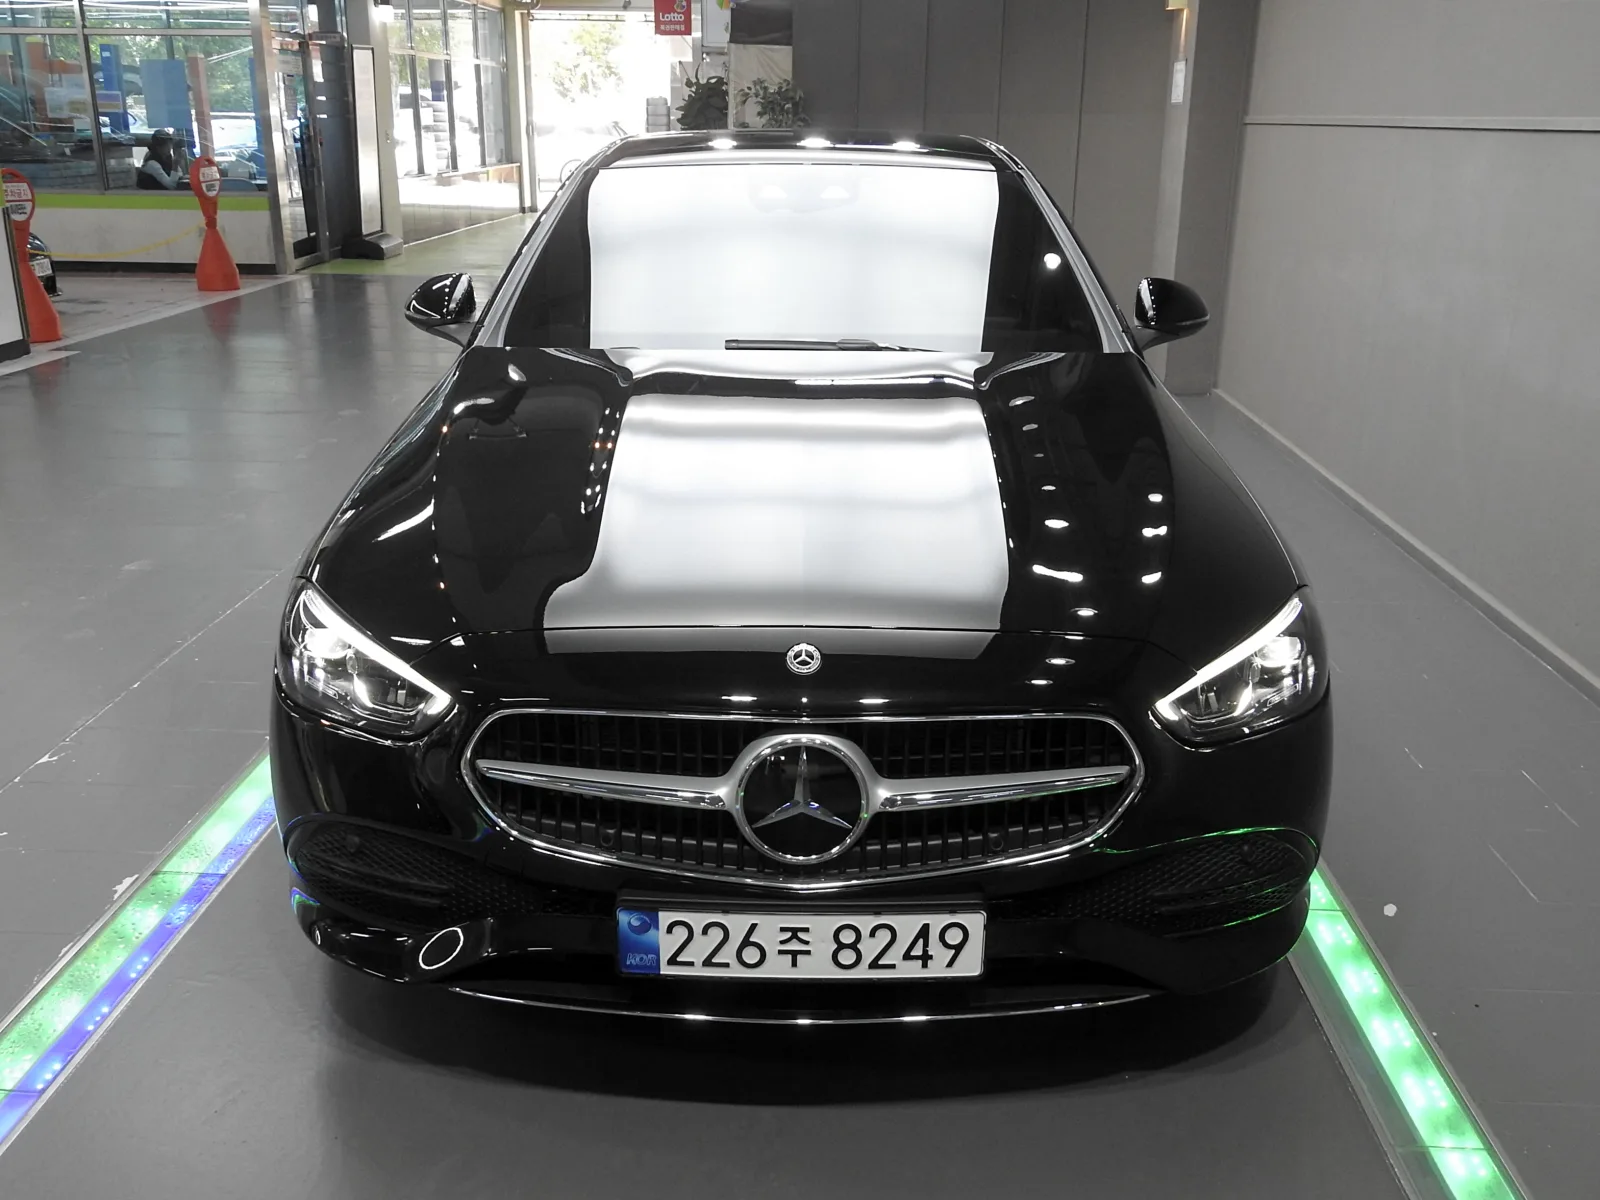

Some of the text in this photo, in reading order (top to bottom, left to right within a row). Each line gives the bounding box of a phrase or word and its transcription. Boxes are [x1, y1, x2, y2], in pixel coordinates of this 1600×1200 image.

[659, 12, 685, 21] Lotto
[665, 919, 970, 970] 226주 8249
[626, 952, 657, 966] KOR
